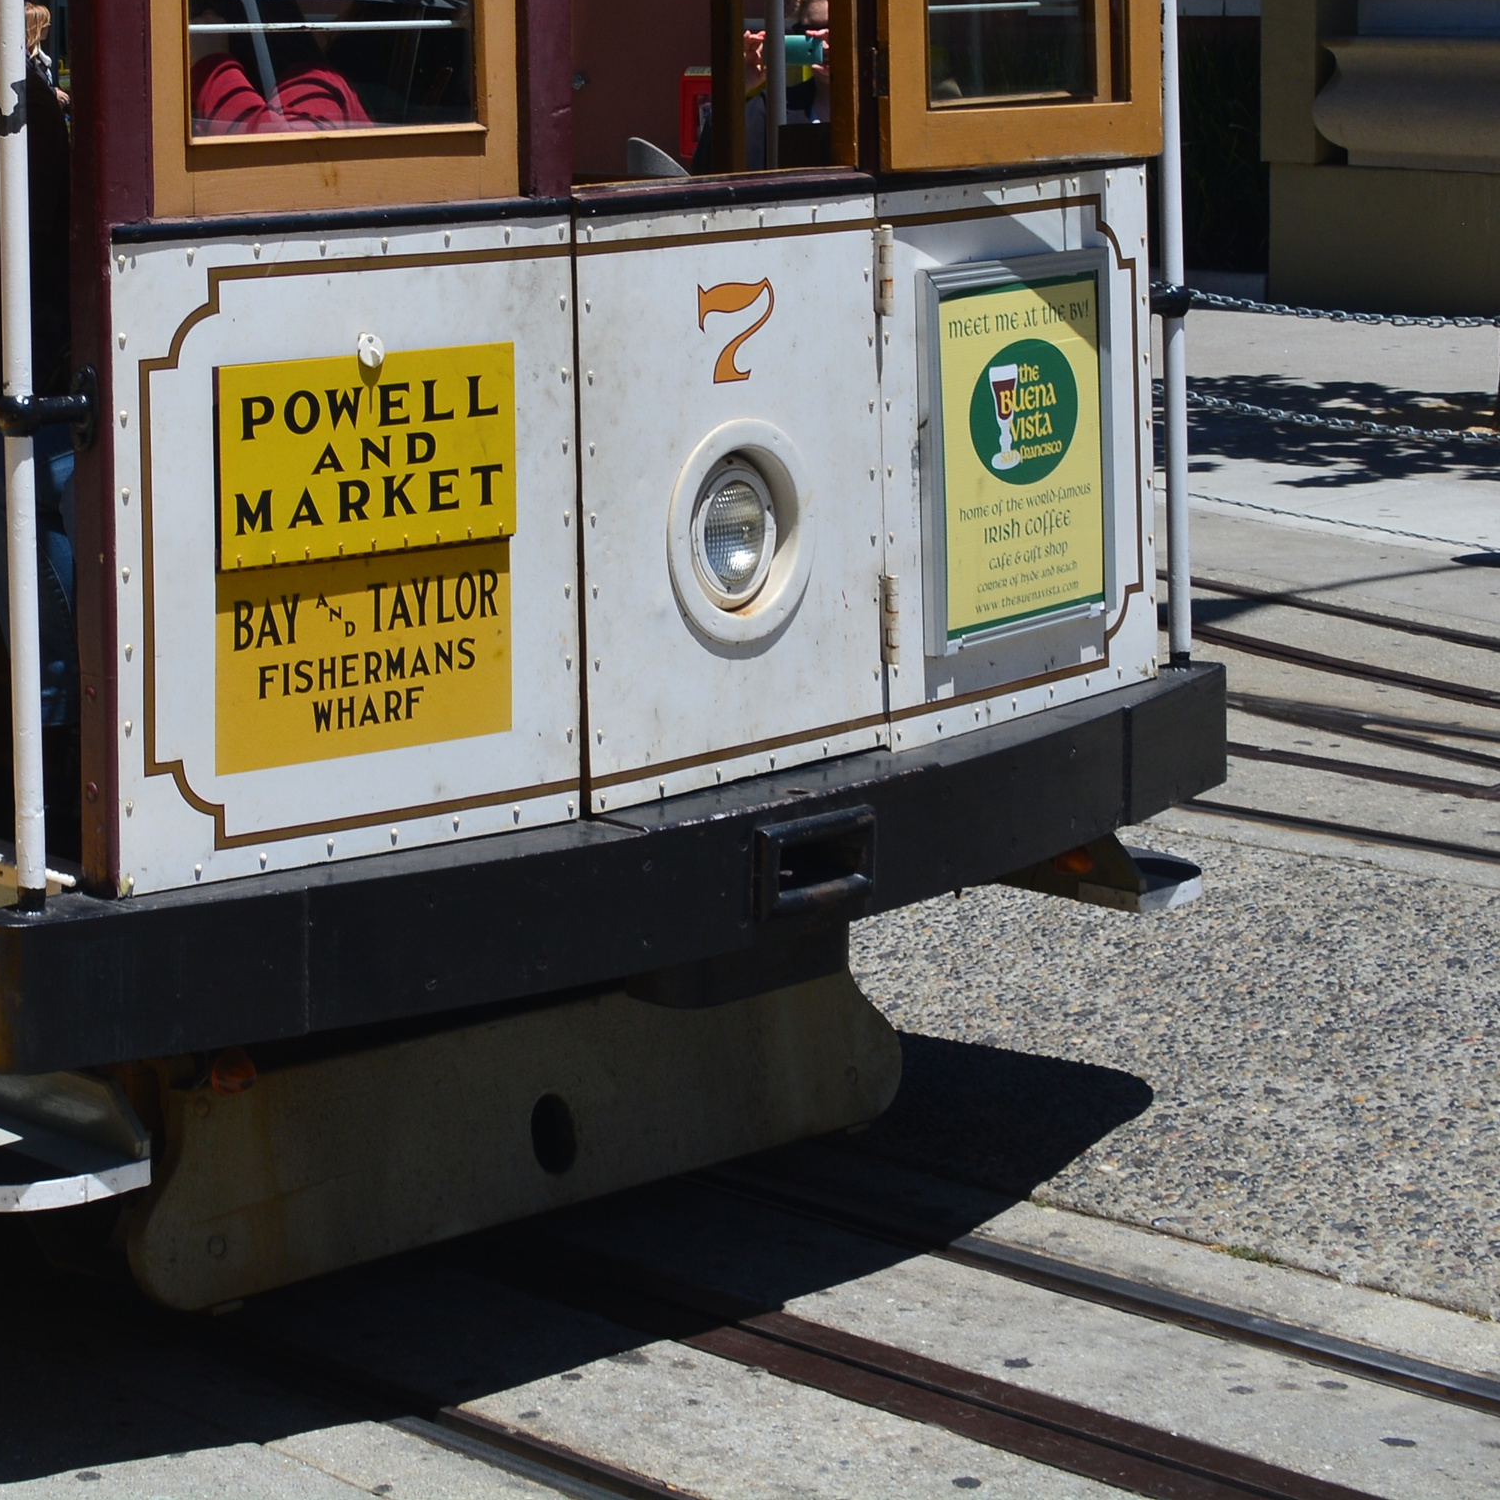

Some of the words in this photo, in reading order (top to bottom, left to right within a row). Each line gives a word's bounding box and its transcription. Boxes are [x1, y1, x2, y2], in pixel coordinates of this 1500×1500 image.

[697, 276, 775, 384] 7
[240, 375, 499, 441] POWELL
[311, 431, 437, 475] AND
[235, 463, 503, 536] MARKET
[233, 594, 300, 652] BAY
[315, 592, 356, 637] AND
[367, 569, 499, 632] TAYLOR
[258, 638, 476, 700] FISHERMANS
[313, 686, 424, 734] WHARF
